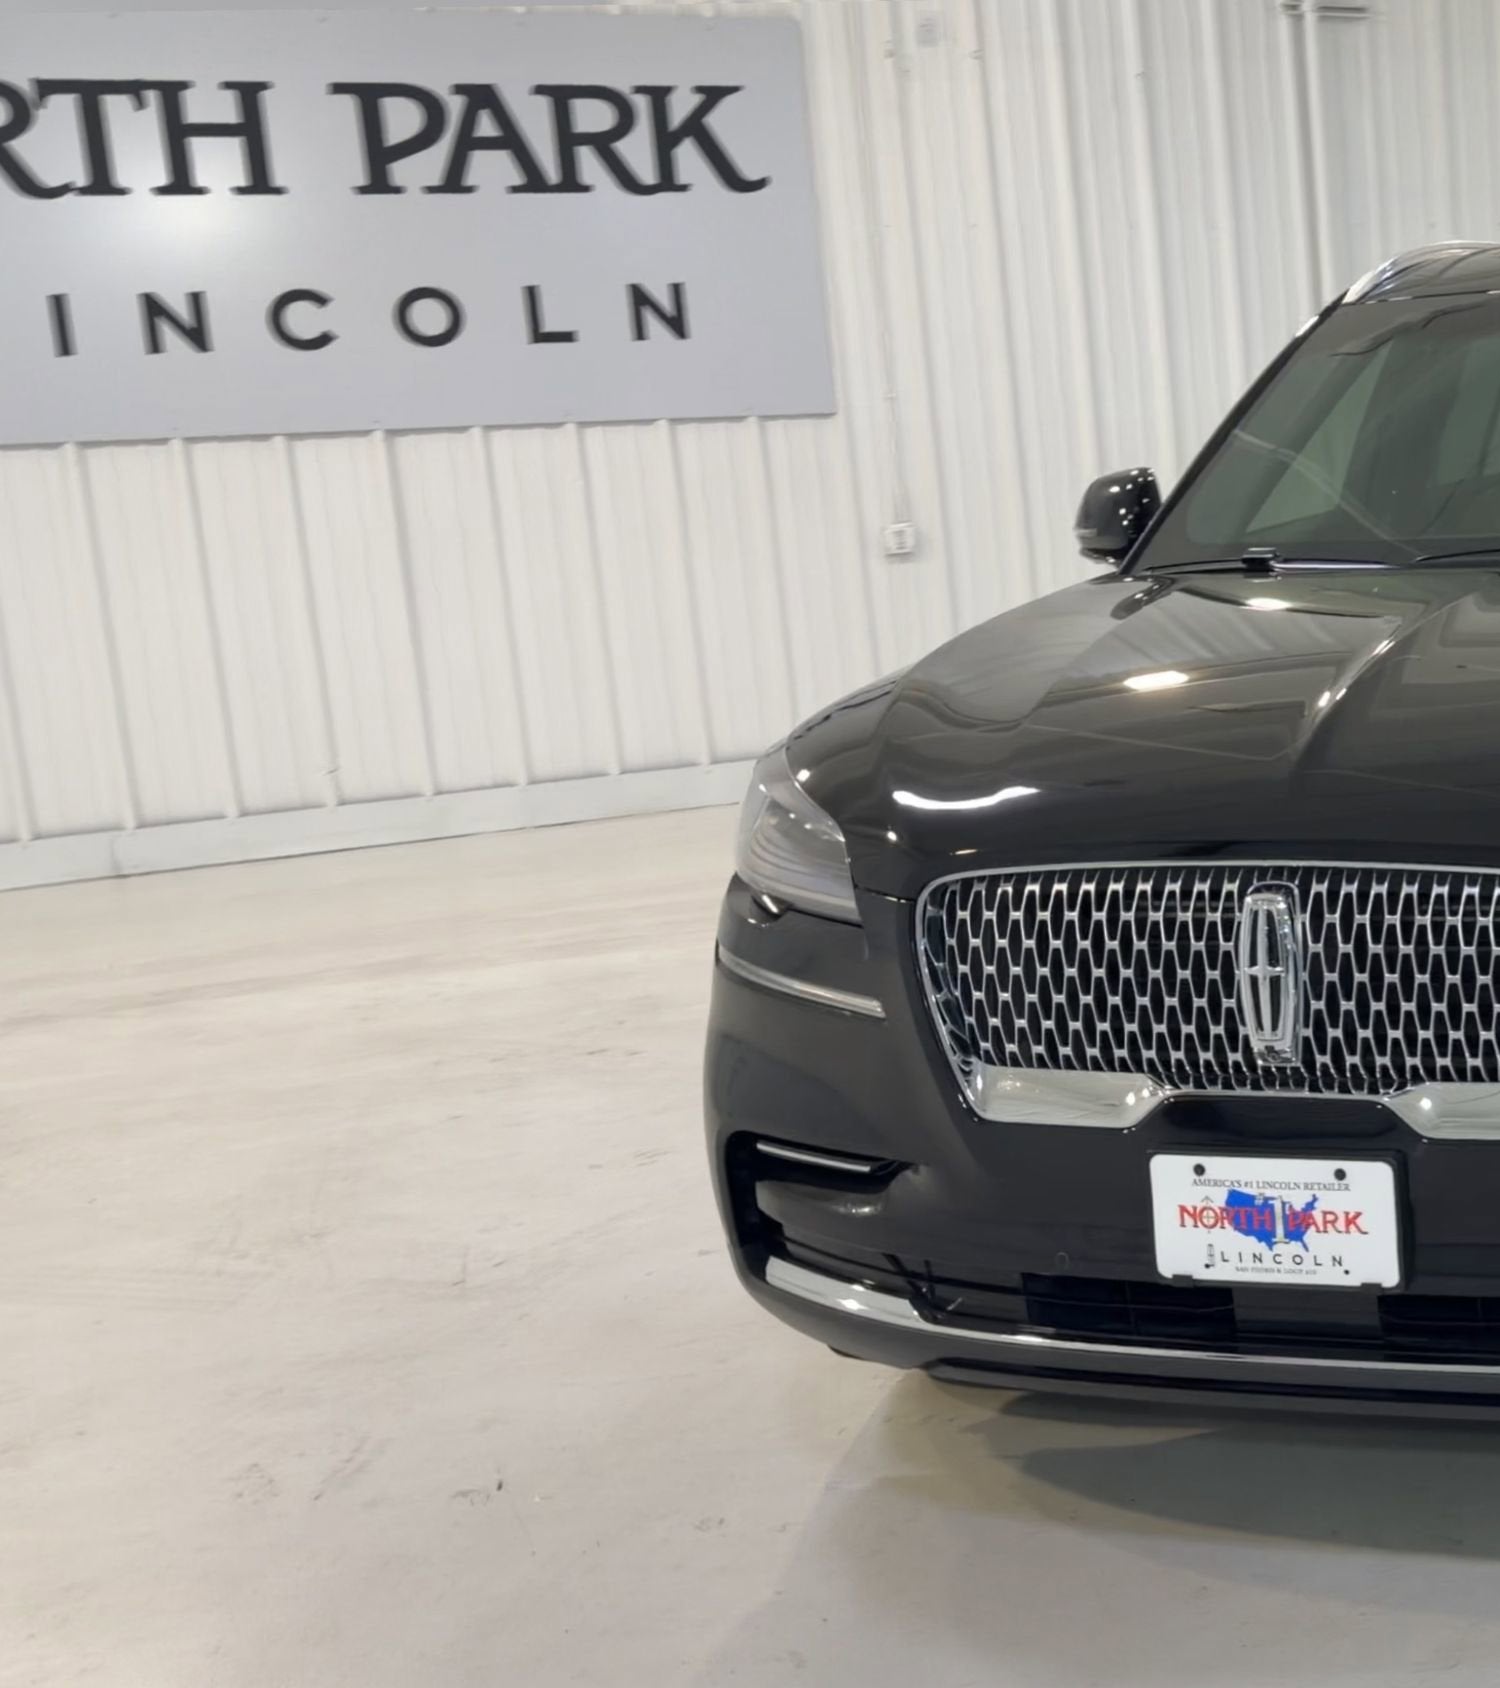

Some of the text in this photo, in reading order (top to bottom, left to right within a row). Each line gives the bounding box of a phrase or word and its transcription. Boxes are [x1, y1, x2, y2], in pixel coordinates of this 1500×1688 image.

[330, 83, 769, 195] PARK
[50, 283, 688, 357] INCOLN
[1192, 1178, 1351, 1191] AMERICA'S #1 LINCOLN RETAILER
[1178, 1204, 1369, 1234] NORTH PARK
[1220, 1251, 1343, 1267] LINCOLN
